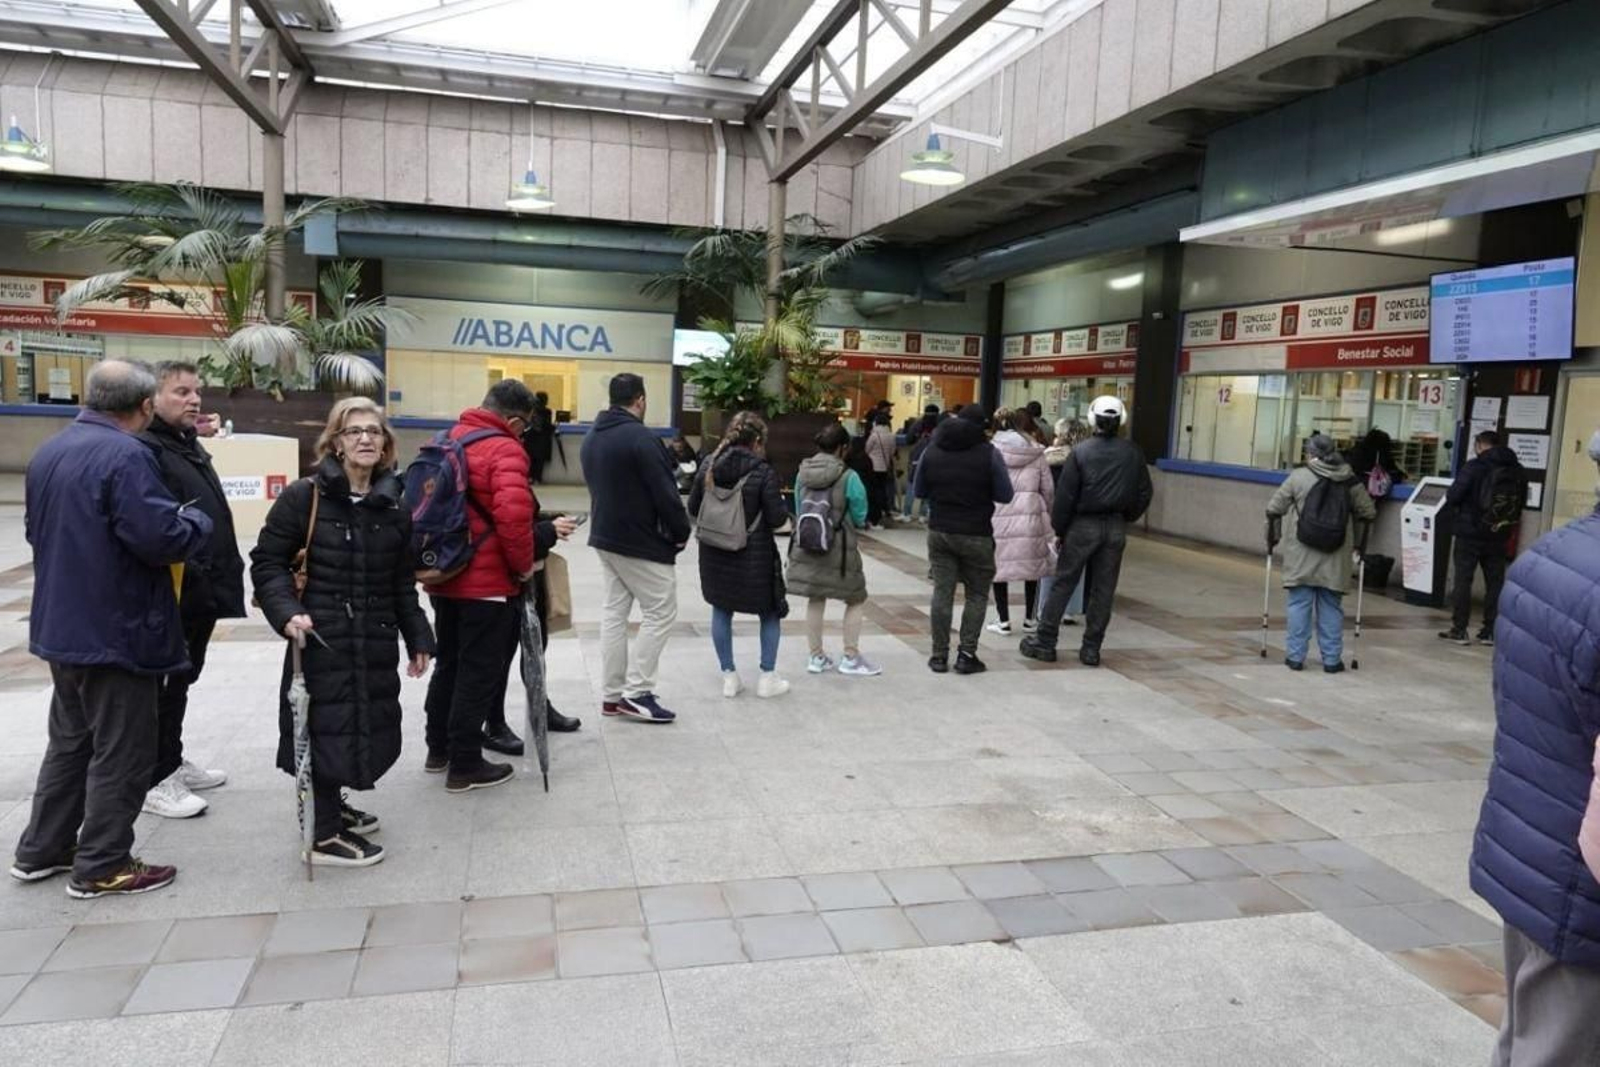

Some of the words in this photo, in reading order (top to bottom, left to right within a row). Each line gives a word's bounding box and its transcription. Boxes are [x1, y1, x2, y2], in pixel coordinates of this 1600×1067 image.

[0, 283, 37, 291] NCELLO
[1307, 305, 1349, 317] CONCELLO
[1388, 311, 1401, 321] DE
[1404, 309, 1427, 320] VIGO
[0, 314, 41, 324] adación
[44, 316, 97, 327] Vountaria
[1187, 319, 1218, 329] CONCELLO
[1242, 312, 1277, 324] CONCELLO
[1311, 319, 1322, 328] DE
[1324, 317, 1343, 326] VIGO
[1245, 324, 1254, 333] DE
[1256, 323, 1272, 332] VIGO
[466, 317, 613, 353] ABANCA
[4, 340, 14, 352] 4
[1337, 347, 1380, 360] Benestar
[1383, 345, 1414, 359] Social
[904, 383, 912, 394] 9
[924, 382, 933, 395] 9
[1218, 387, 1231, 404] 12
[1420, 385, 1441, 405] 13
[221, 480, 260, 489] ONCELLO
[236, 488, 256, 496] VIGO
